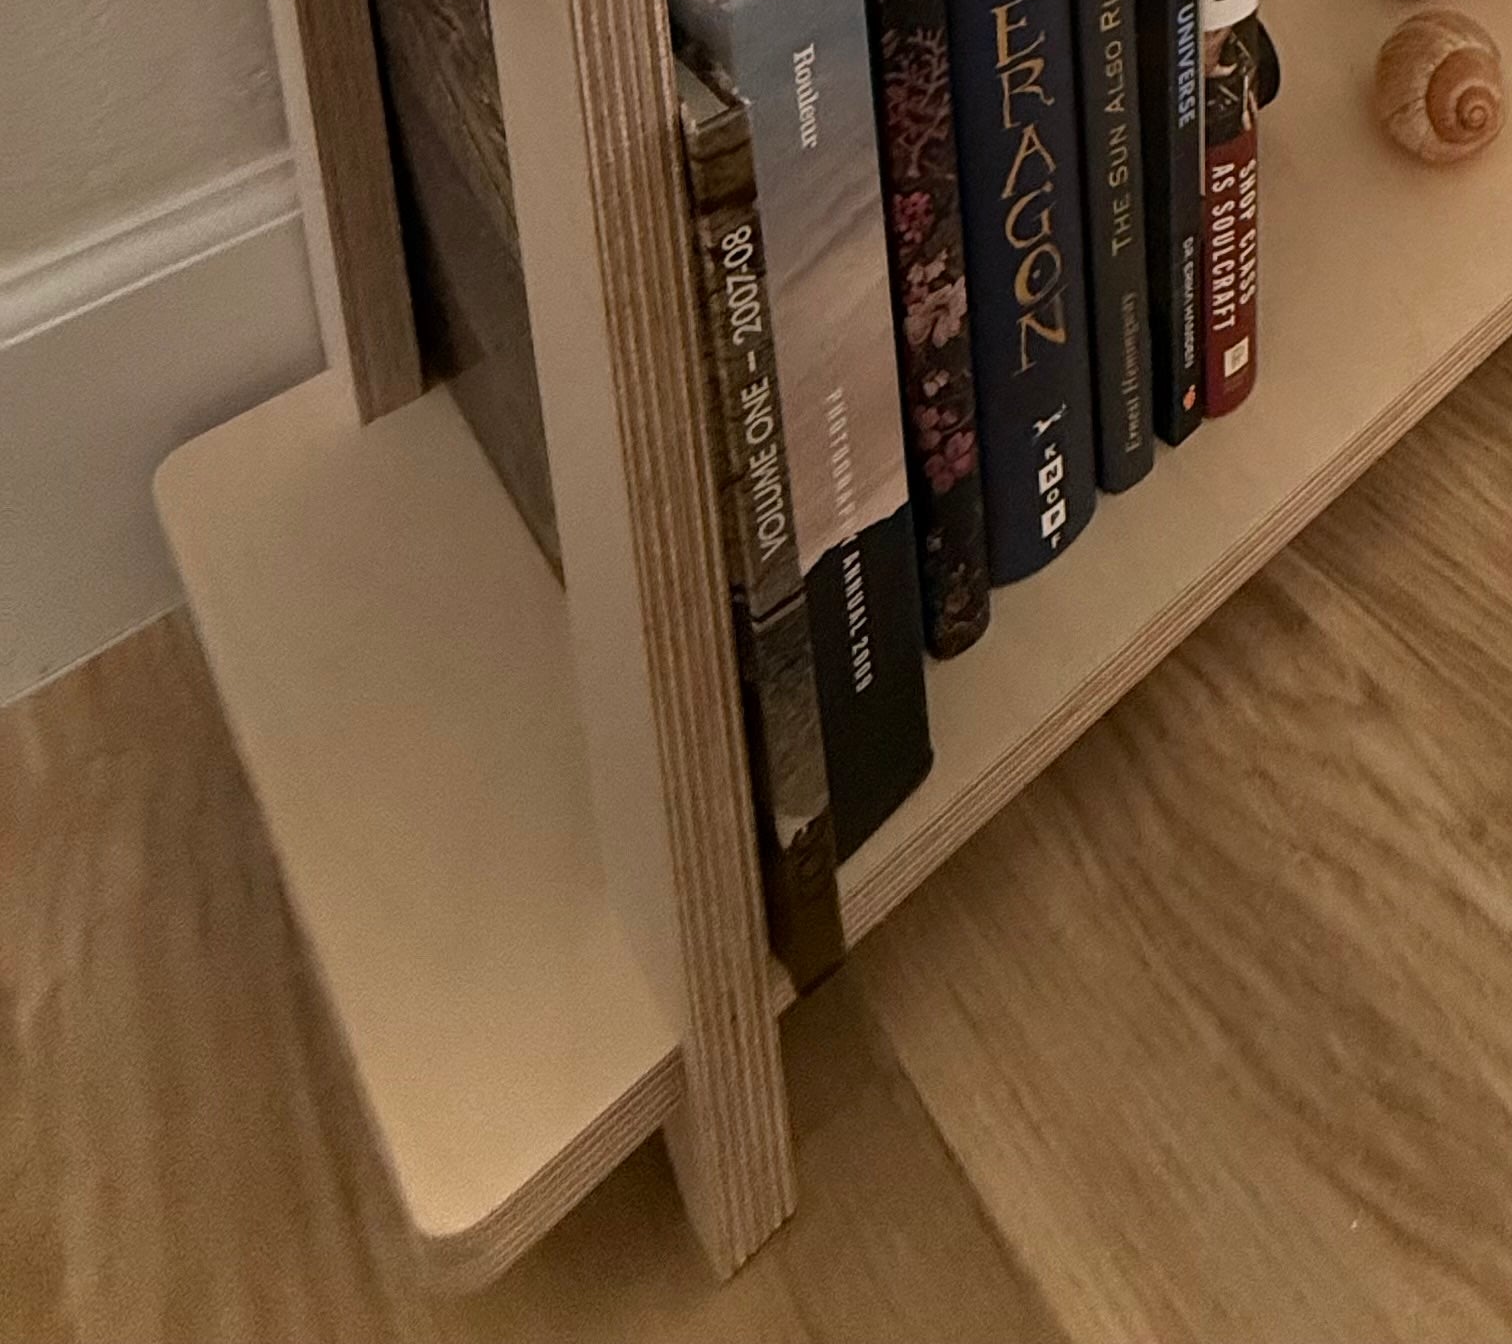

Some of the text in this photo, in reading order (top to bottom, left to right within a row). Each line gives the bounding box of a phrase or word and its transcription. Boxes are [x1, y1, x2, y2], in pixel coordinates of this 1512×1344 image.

[793, 43, 819, 149] Rouleur
[1104, 40, 1125, 113] ALSO
[1177, 3, 1196, 129] UNIVERSE
[1109, 123, 1128, 188] SUN
[1112, 192, 1132, 256] THE
[1212, 163, 1236, 331] AS SOULCRAFT
[1239, 159, 1256, 305] SHOP CLASS
[721, 224, 762, 346] 2007-08
[740, 375, 775, 446] ONE
[756, 443, 788, 563] VOLUME
